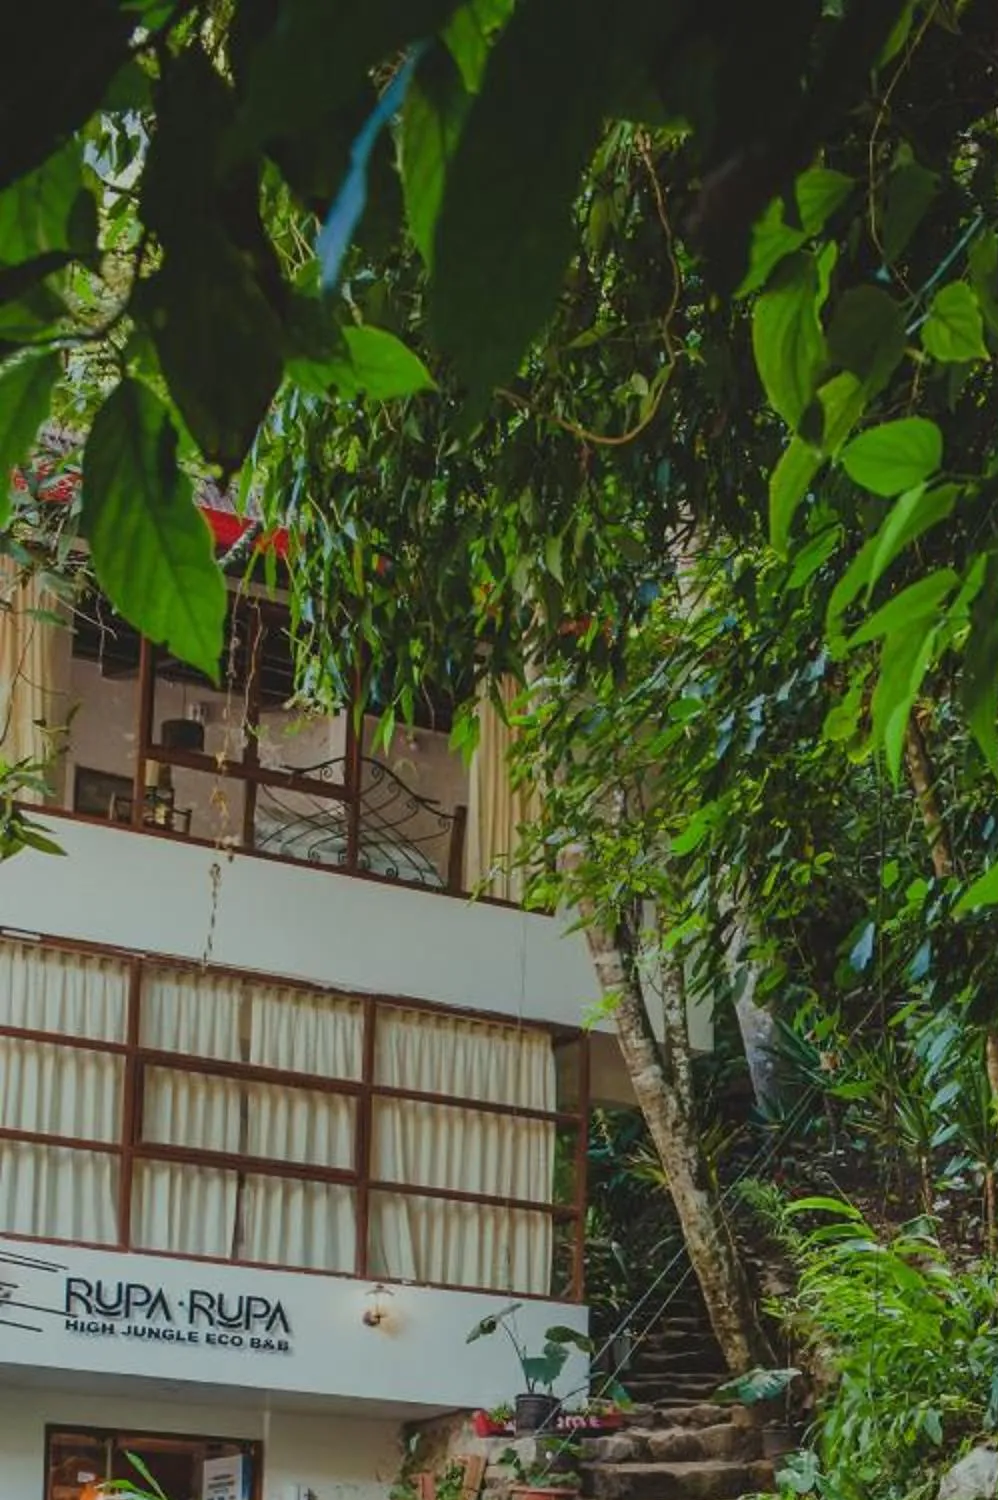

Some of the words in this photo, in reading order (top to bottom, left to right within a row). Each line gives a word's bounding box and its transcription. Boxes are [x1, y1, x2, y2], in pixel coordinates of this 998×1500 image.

[65, 1277, 173, 1322] RUPA
[189, 1289, 291, 1333] RUPA
[65, 1319, 115, 1335] HIGH
[121, 1325, 199, 1343] JUNGLE
[205, 1332, 243, 1347] ECO
[250, 1338, 290, 1352] B&B
